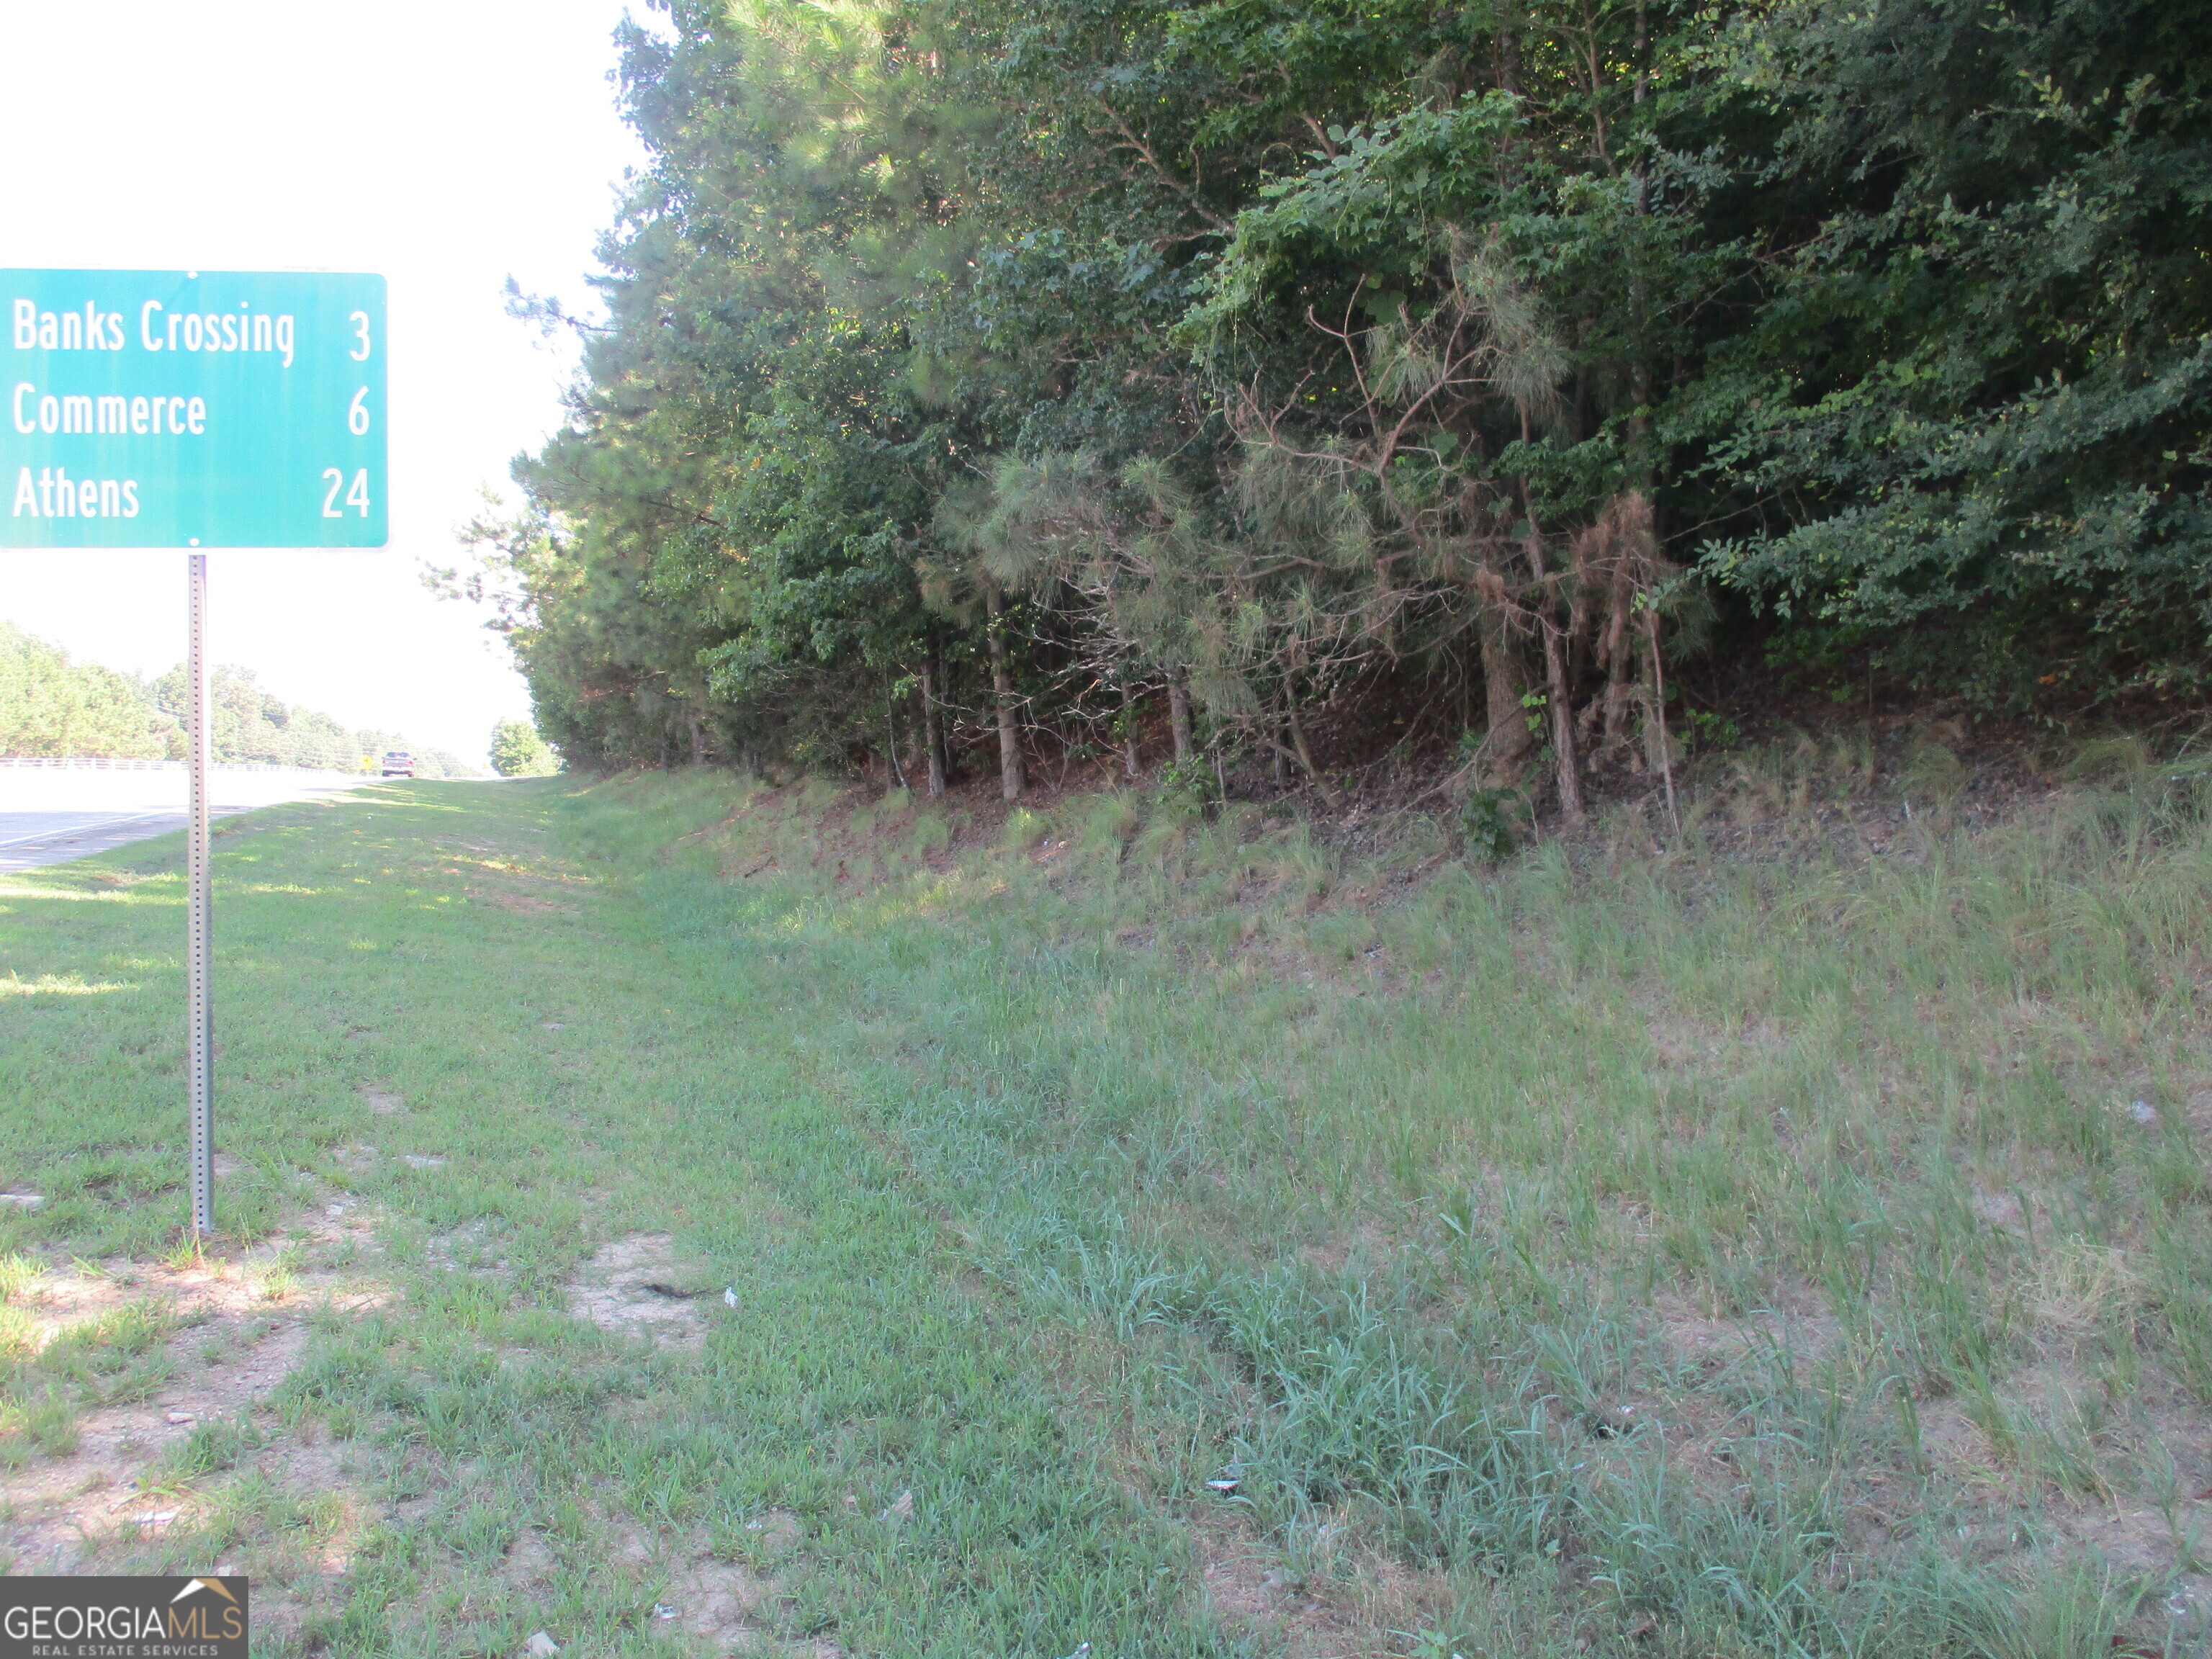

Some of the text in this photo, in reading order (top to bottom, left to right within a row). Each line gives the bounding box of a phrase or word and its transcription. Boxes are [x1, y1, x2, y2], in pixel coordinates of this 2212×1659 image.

[13, 298, 371, 369] Banks Crossing 3
[13, 382, 370, 436] Commerce 6
[12, 467, 371, 518] Athens 24
